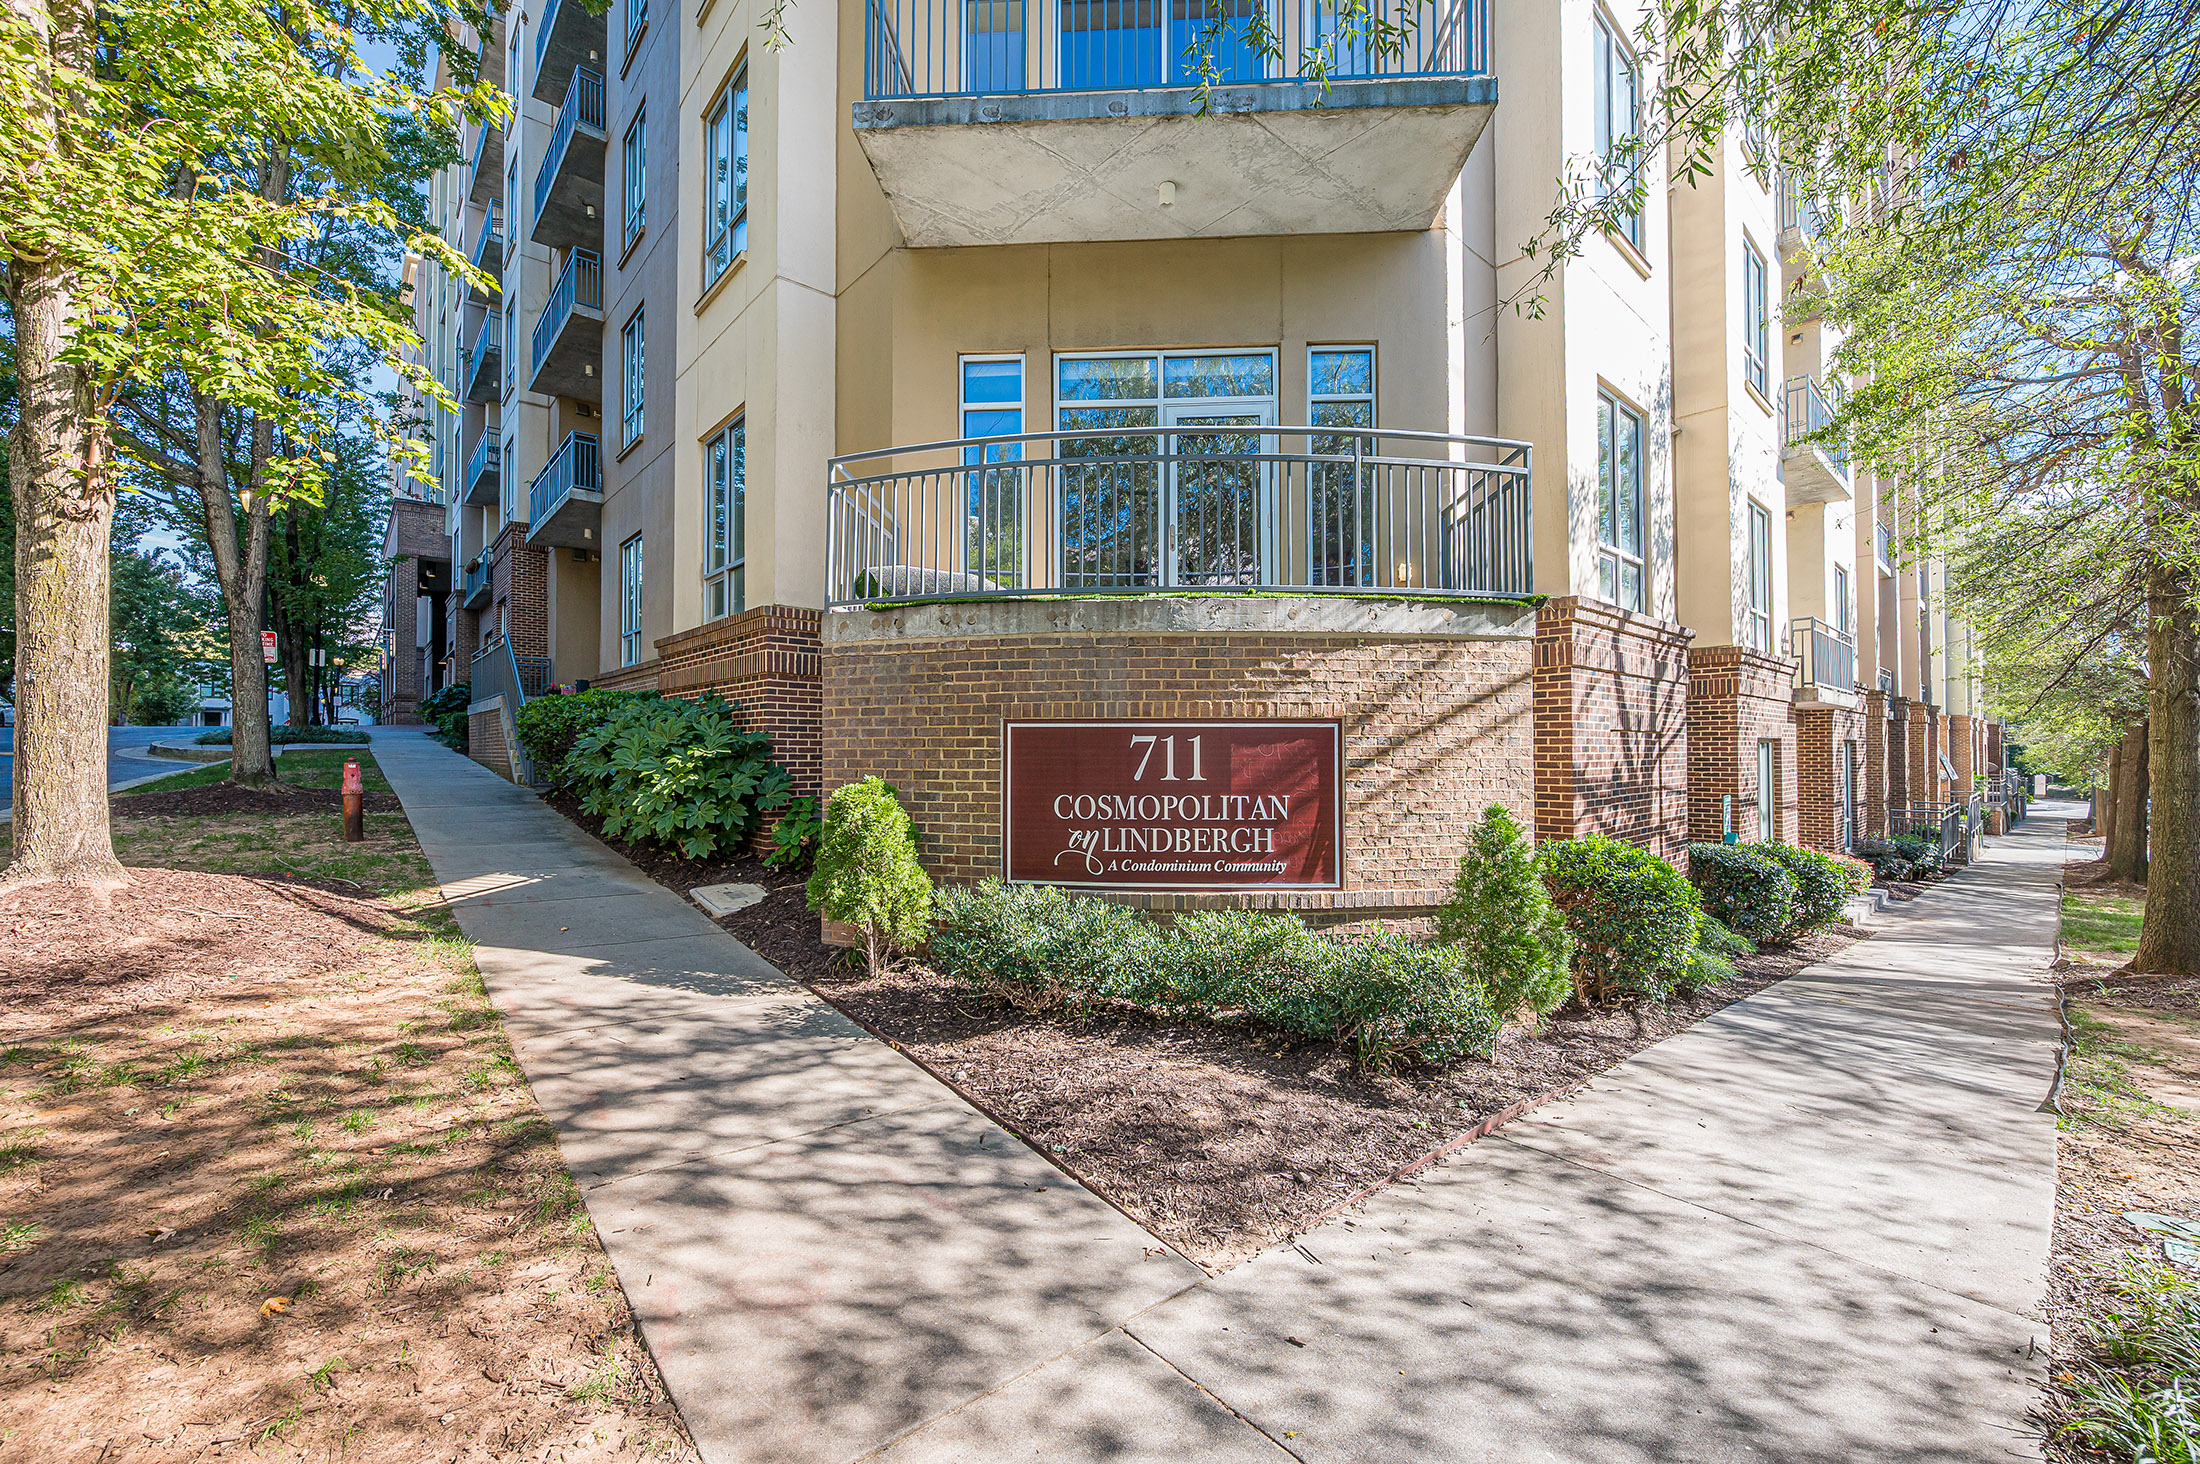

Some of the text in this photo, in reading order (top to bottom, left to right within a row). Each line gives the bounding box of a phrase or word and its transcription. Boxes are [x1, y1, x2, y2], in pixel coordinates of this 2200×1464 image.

[1130, 734, 1207, 781] 711
[1053, 794, 1290, 821] COSMOPOLITAN
[1054, 828, 1275, 876] on LINDBERGH
[1107, 859, 1287, 874] A Condominium Community
